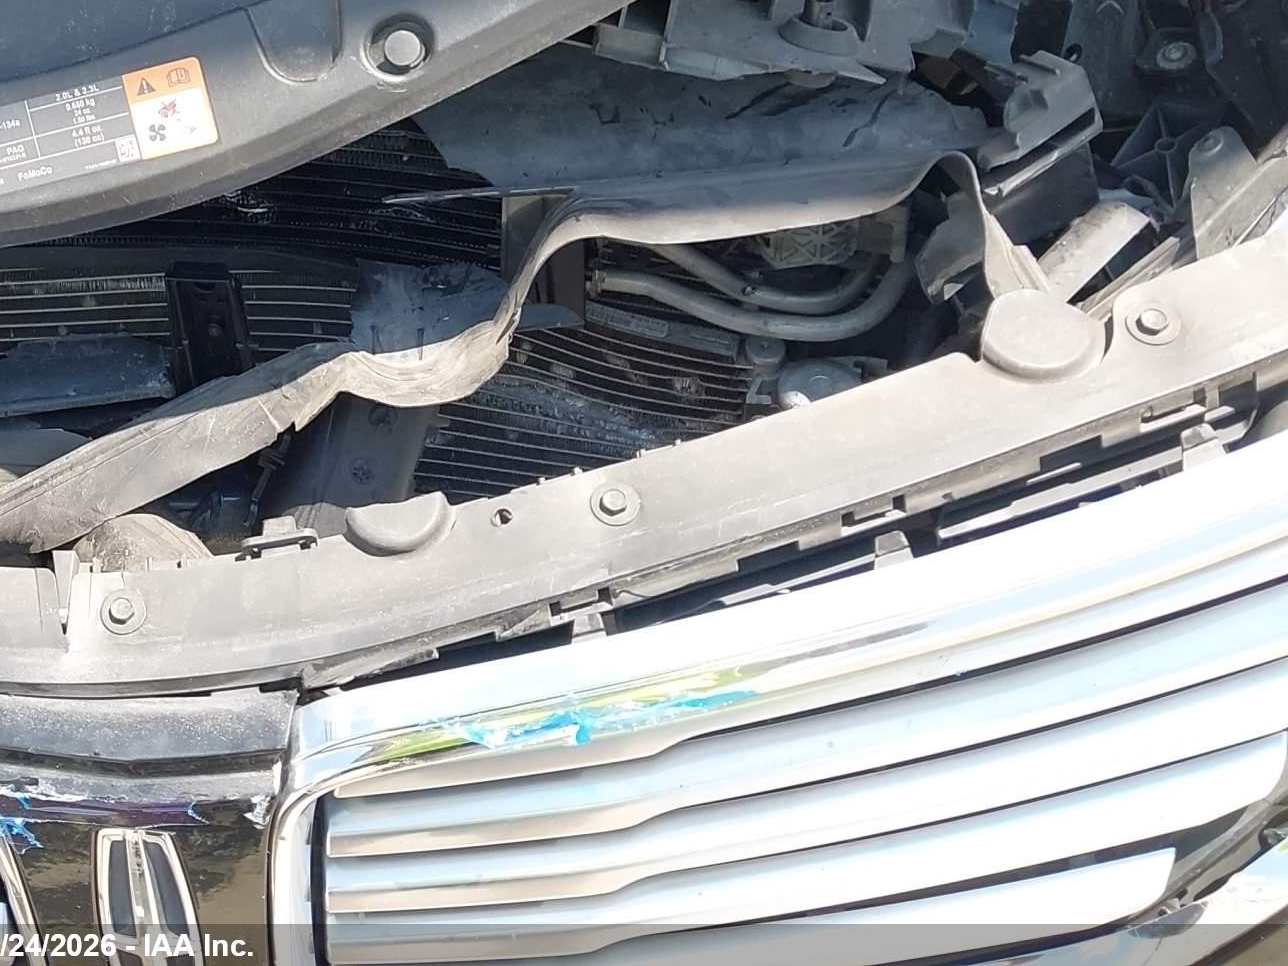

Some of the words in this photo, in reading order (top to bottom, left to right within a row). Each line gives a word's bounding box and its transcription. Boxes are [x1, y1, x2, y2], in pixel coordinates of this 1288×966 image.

[55, 91, 73, 102] 2.0L
[74, 88, 81, 96] &
[85, 96, 95, 107] kg
[6, 144, 24, 155] PAG
[17, 165, 53, 181] FoMoCo
